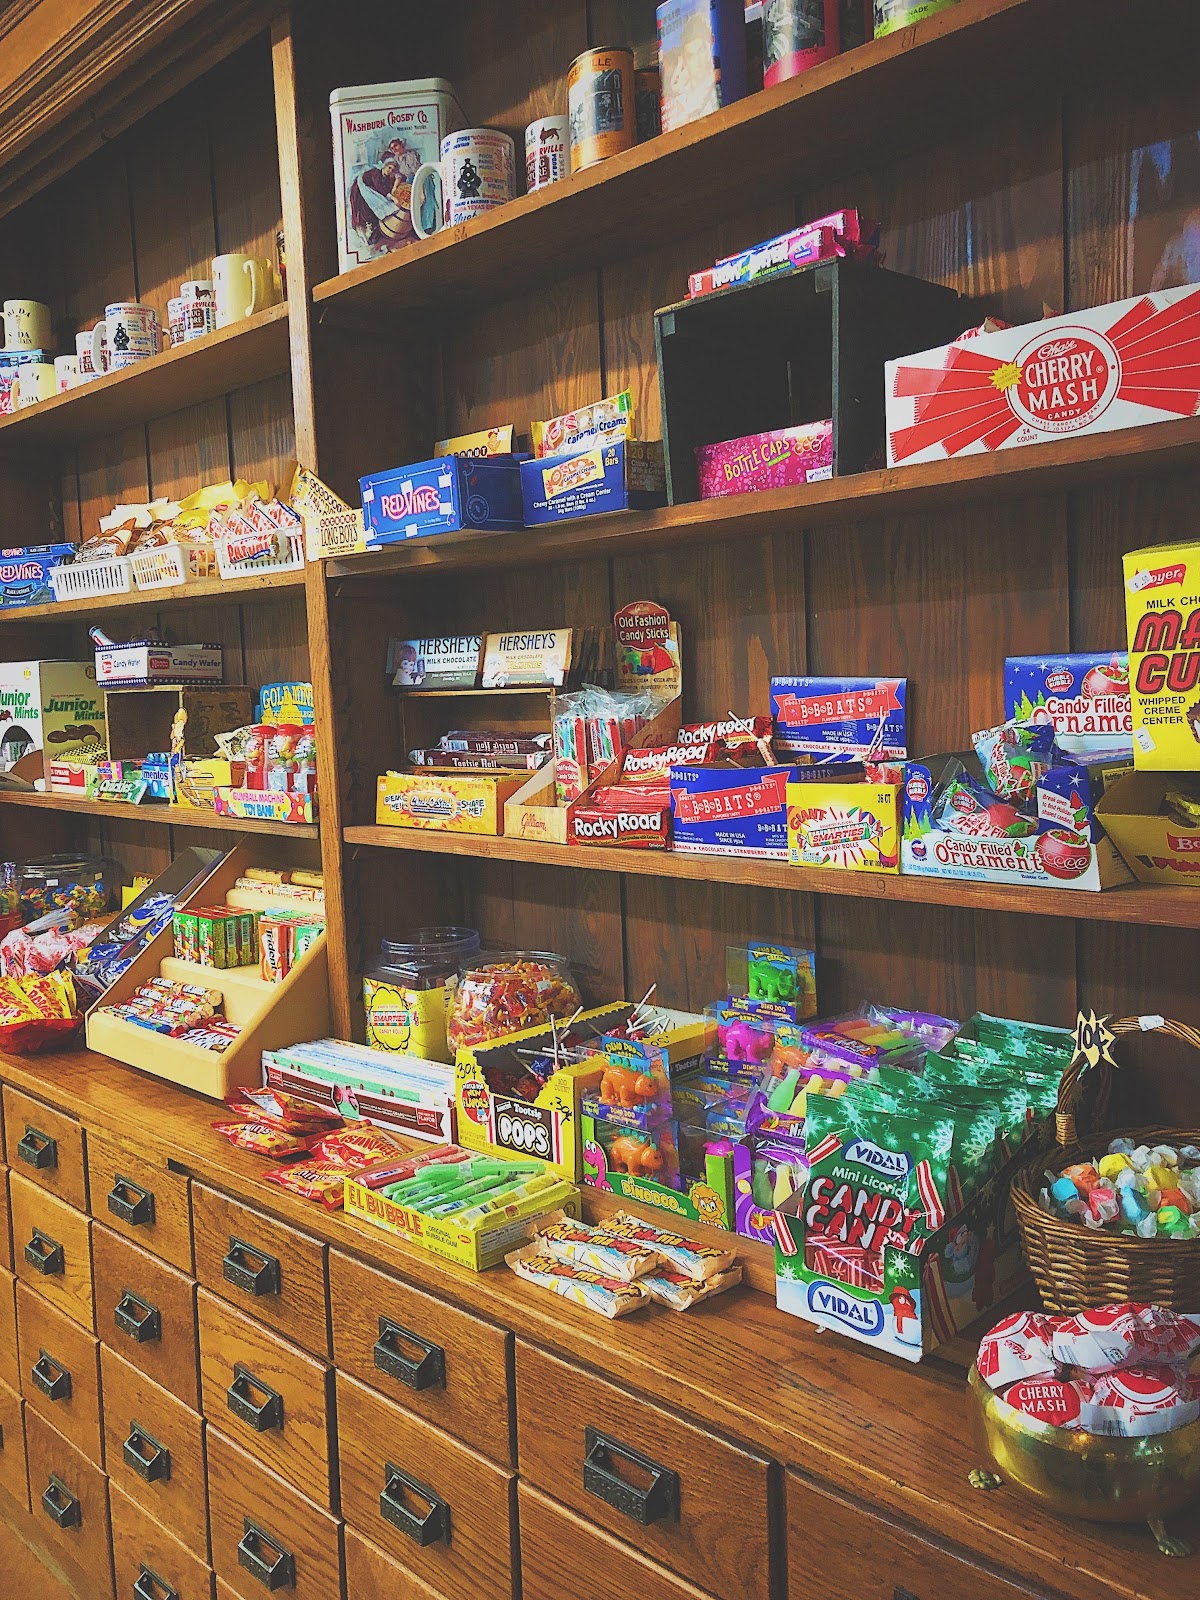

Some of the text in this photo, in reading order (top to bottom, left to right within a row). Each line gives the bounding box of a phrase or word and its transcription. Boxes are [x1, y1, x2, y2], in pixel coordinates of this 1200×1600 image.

[346, 118, 386, 134] WASHBURN
[388, 111, 415, 129] CROSBY
[1038, 340, 1077, 359] Chase
[1026, 350, 1095, 388] CHERRY
[1028, 378, 1098, 413] MASH
[1031, 417, 1052, 426] CHASE
[1053, 418, 1073, 427] CANDY
[1048, 408, 1082, 421] CANDY
[567, 417, 628, 445] Caramel Creams
[1017, 434, 1039, 444] COUNT
[607, 447, 617, 458] 20
[724, 438, 790, 482] BOTTLE CAPS
[605, 456, 619, 467] Bars
[581, 464, 597, 477] Creams
[405, 485, 441, 515] VINES
[533, 500, 548, 509] Chewy
[548, 497, 566, 506] Caramel
[596, 488, 611, 496] Center
[15, 562, 43, 580] VINES
[1146, 598, 1175, 610] MILK
[618, 613, 667, 628] Old Fashion
[499, 632, 556, 651] HERSHEY'S
[620, 628, 669, 642] Candy Sticks
[418, 635, 482, 655] HERSHEY'S
[172, 658, 198, 668] Candy
[199, 659, 221, 667] Wafer
[426, 655, 477, 665] MILK CHOCOLATE
[1047, 674, 1070, 683] DUBBLE
[44, 698, 98, 713] Junior
[1047, 697, 1133, 717] Candy Filled
[1138, 696, 1186, 706] WHIPPED
[14, 709, 39, 719] Mints
[74, 711, 105, 721] Mints
[1144, 705, 1181, 715] CREME
[1033, 708, 1133, 733] Orname
[1142, 716, 1184, 726] CENTER
[677, 717, 756, 744] Rocky Road
[803, 743, 869, 753] CHOCOLATE STRAWBERR
[452, 757, 497, 768] Tootsie Roll
[623, 744, 709, 772] Rocky Road
[143, 770, 169, 781] mentos
[232, 792, 285, 804] GUMBALL MACHINE
[884, 794, 891, 803] CT
[1042, 793, 1056, 803] Break
[244, 804, 275, 817] TOY BANK
[574, 811, 661, 837] Rocky Road
[789, 808, 827, 830] GIANT
[812, 827, 864, 843] SMARTIES
[698, 845, 726, 853] CHOCOLATE
[734, 848, 767, 856] STRAWBERRY
[945, 838, 1012, 856] Candy Filled
[935, 842, 1044, 872] Ornament
[264, 929, 278, 971] Trident
[760, 1003, 787, 1013] DINO DOO
[372, 1013, 407, 1023] SMARTIES
[605, 1041, 622, 1054] DINO
[674, 1058, 698, 1073] Tootsie
[514, 1103, 543, 1120] Tootsie
[499, 1114, 550, 1157] POPS
[856, 1143, 907, 1172] VIDAL
[831, 1164, 909, 1199] Mini Licorice
[621, 1177, 680, 1208] DINO DOO
[348, 1184, 424, 1238] EL BUBBLE
[811, 1177, 921, 1233] CANDY
[425, 1230, 458, 1249] BUBBLE GUM
[427, 1225, 452, 1239] ORIGINAL
[818, 1291, 875, 1326] VIDAL
[1018, 1383, 1064, 1401] CHERRY
[1020, 1398, 1068, 1414] MASH
